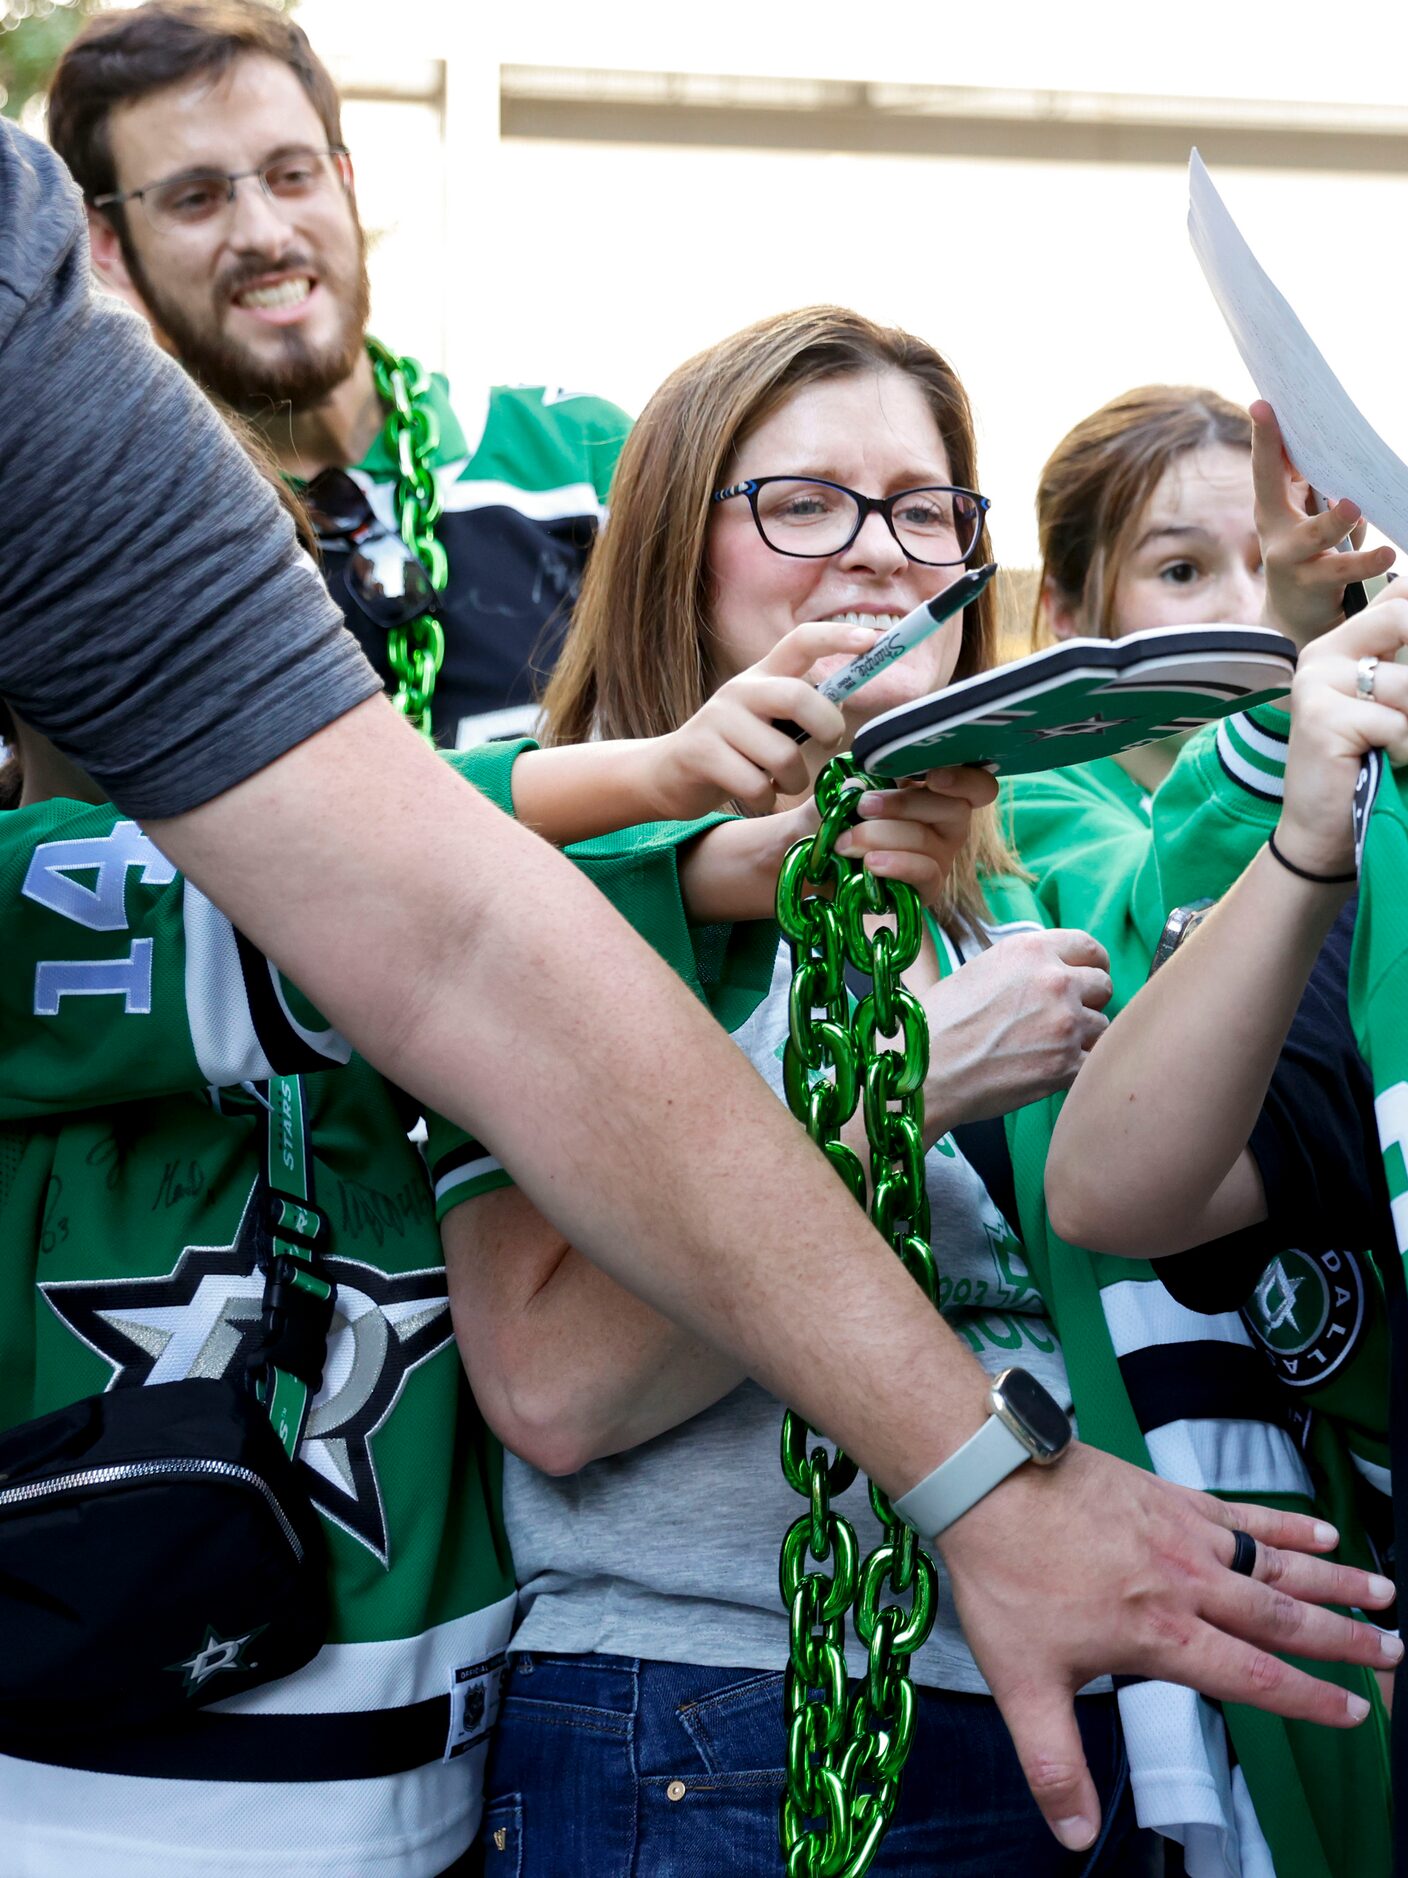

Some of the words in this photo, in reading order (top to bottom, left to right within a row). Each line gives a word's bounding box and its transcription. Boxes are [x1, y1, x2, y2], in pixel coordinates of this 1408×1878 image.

[21, 820, 178, 1016] 14
[281, 1078, 294, 1172] STARS
[1265, 1249, 1351, 1375] DALLA
